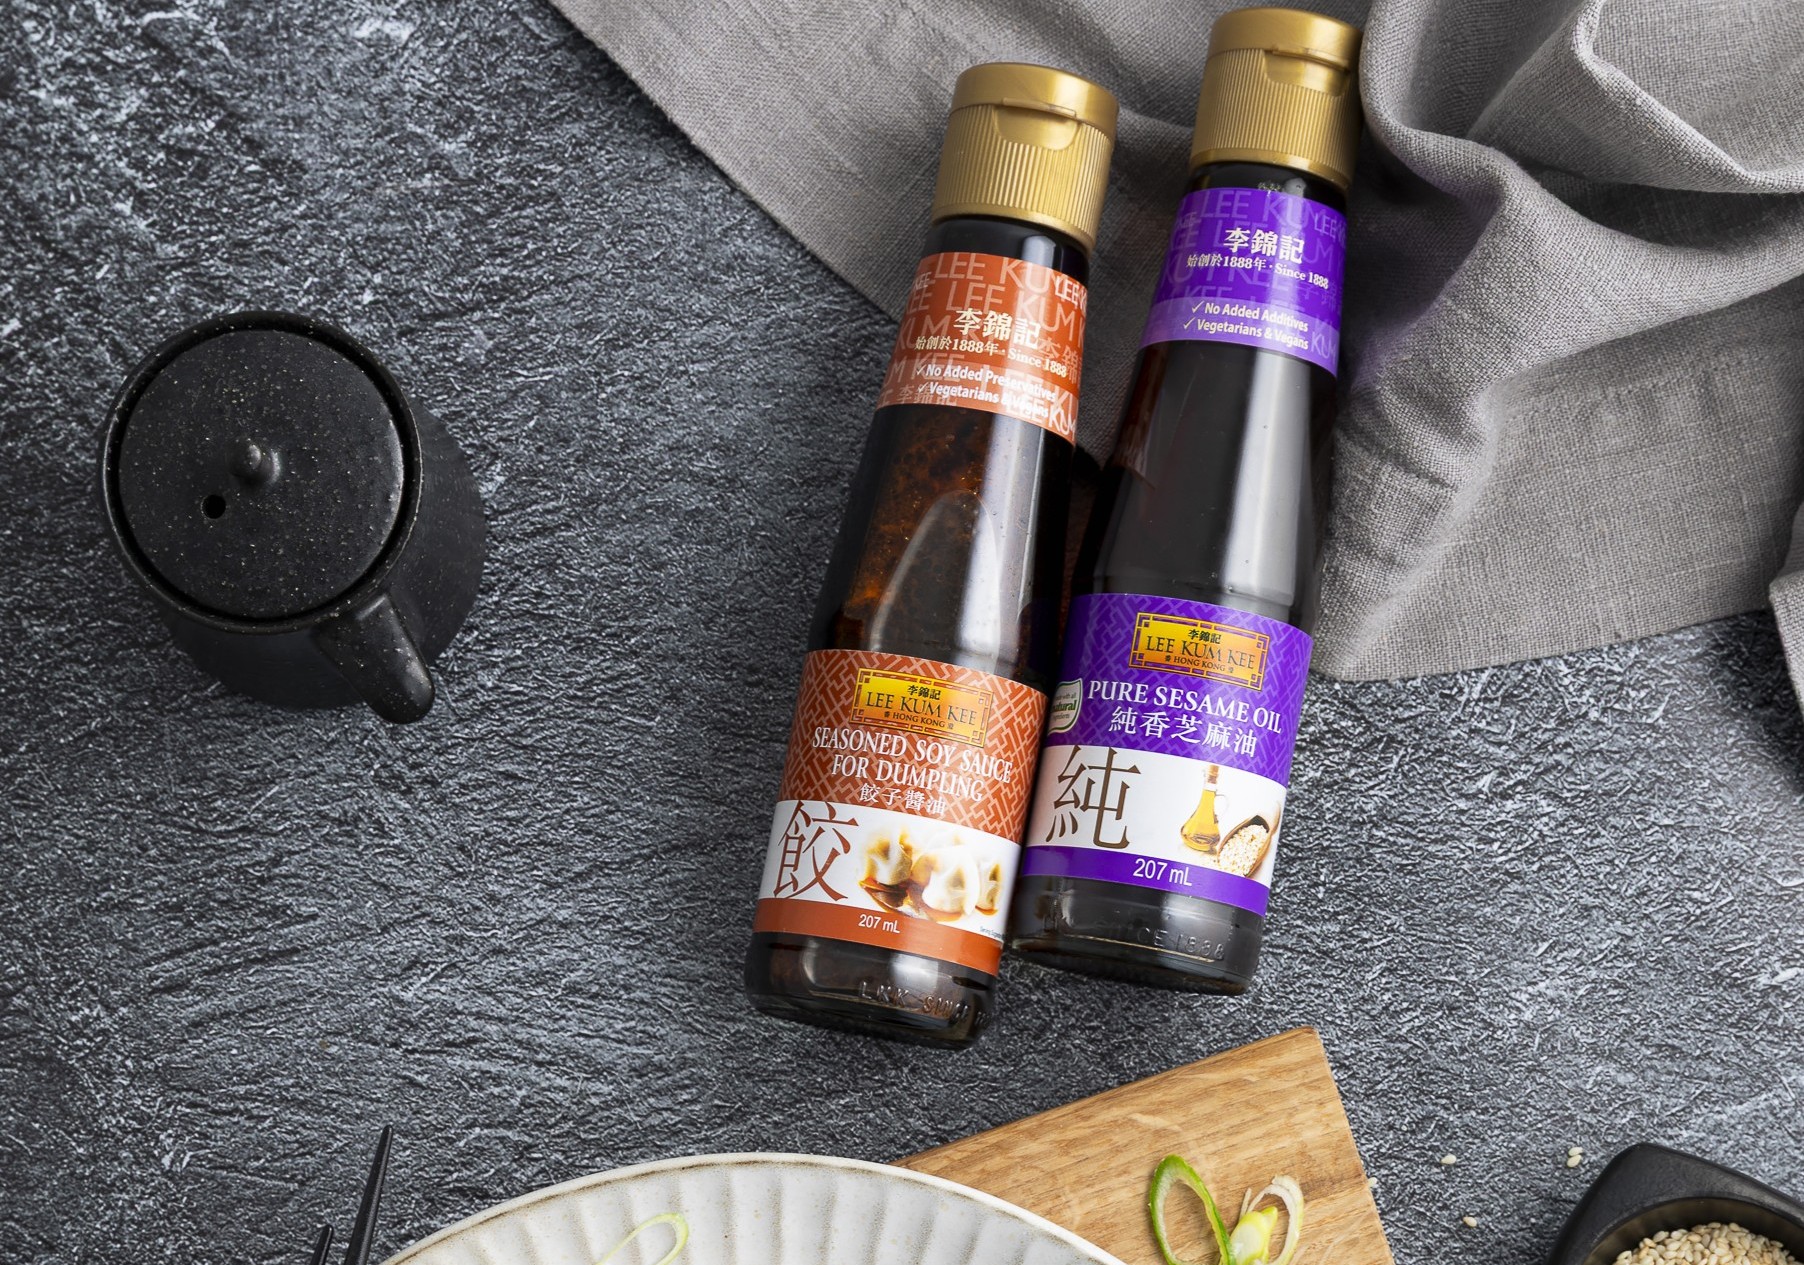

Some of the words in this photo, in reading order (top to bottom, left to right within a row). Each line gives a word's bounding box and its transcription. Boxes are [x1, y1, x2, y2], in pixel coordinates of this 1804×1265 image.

[1223, 227, 1305, 264] 李錦記
[934, 252, 985, 280] LEE
[1274, 263, 1306, 280] Since
[1308, 272, 1329, 290] 1888
[953, 308, 1040, 350] 李錦記
[1204, 302, 1220, 315] No
[1222, 304, 1260, 319] Added
[1261, 310, 1309, 332] Additives
[1197, 319, 1262, 337] Vegetarians
[1264, 326, 1274, 338] &
[1275, 330, 1309, 350] Vegans
[1007, 348, 1041, 368] Since
[1043, 360, 1067, 378] 1888
[926, 364, 941, 377] No
[943, 365, 983, 382] Added
[985, 369, 1057, 401] Preservatives
[929, 382, 999, 403] Vegetarians
[1146, 636, 1175, 653] LEE
[1181, 640, 1221, 662] KUM
[1227, 649, 1256, 669] KEE
[1188, 629, 1221, 644] 李錦記
[1174, 656, 1200, 667] HONG
[1201, 661, 1225, 672] KONG
[866, 691, 894, 709] LEE
[900, 696, 941, 718] KUM
[947, 705, 977, 726] KEE
[907, 684, 941, 701] 李錦記
[1088, 680, 1148, 704] PURE
[1153, 686, 1250, 724] SESAME
[1253, 707, 1282, 734] OIL
[893, 712, 918, 723] HONG
[920, 717, 945, 728] KONG
[1108, 706, 1257, 758] 純香芝麻油
[812, 726, 907, 757] SEASONED
[914, 739, 956, 767] SOY
[960, 749, 1013, 784] SAUCE
[832, 754, 869, 778] FOR
[876, 760, 984, 801] DUMPLING
[859, 782, 947, 815] 餃子醬油
[1045, 745, 1141, 850] 純
[773, 800, 859, 902] 餃
[1133, 858, 1168, 880] 207
[1169, 866, 1192, 887] mL
[858, 913, 881, 928] 207
[882, 919, 900, 934] mL
